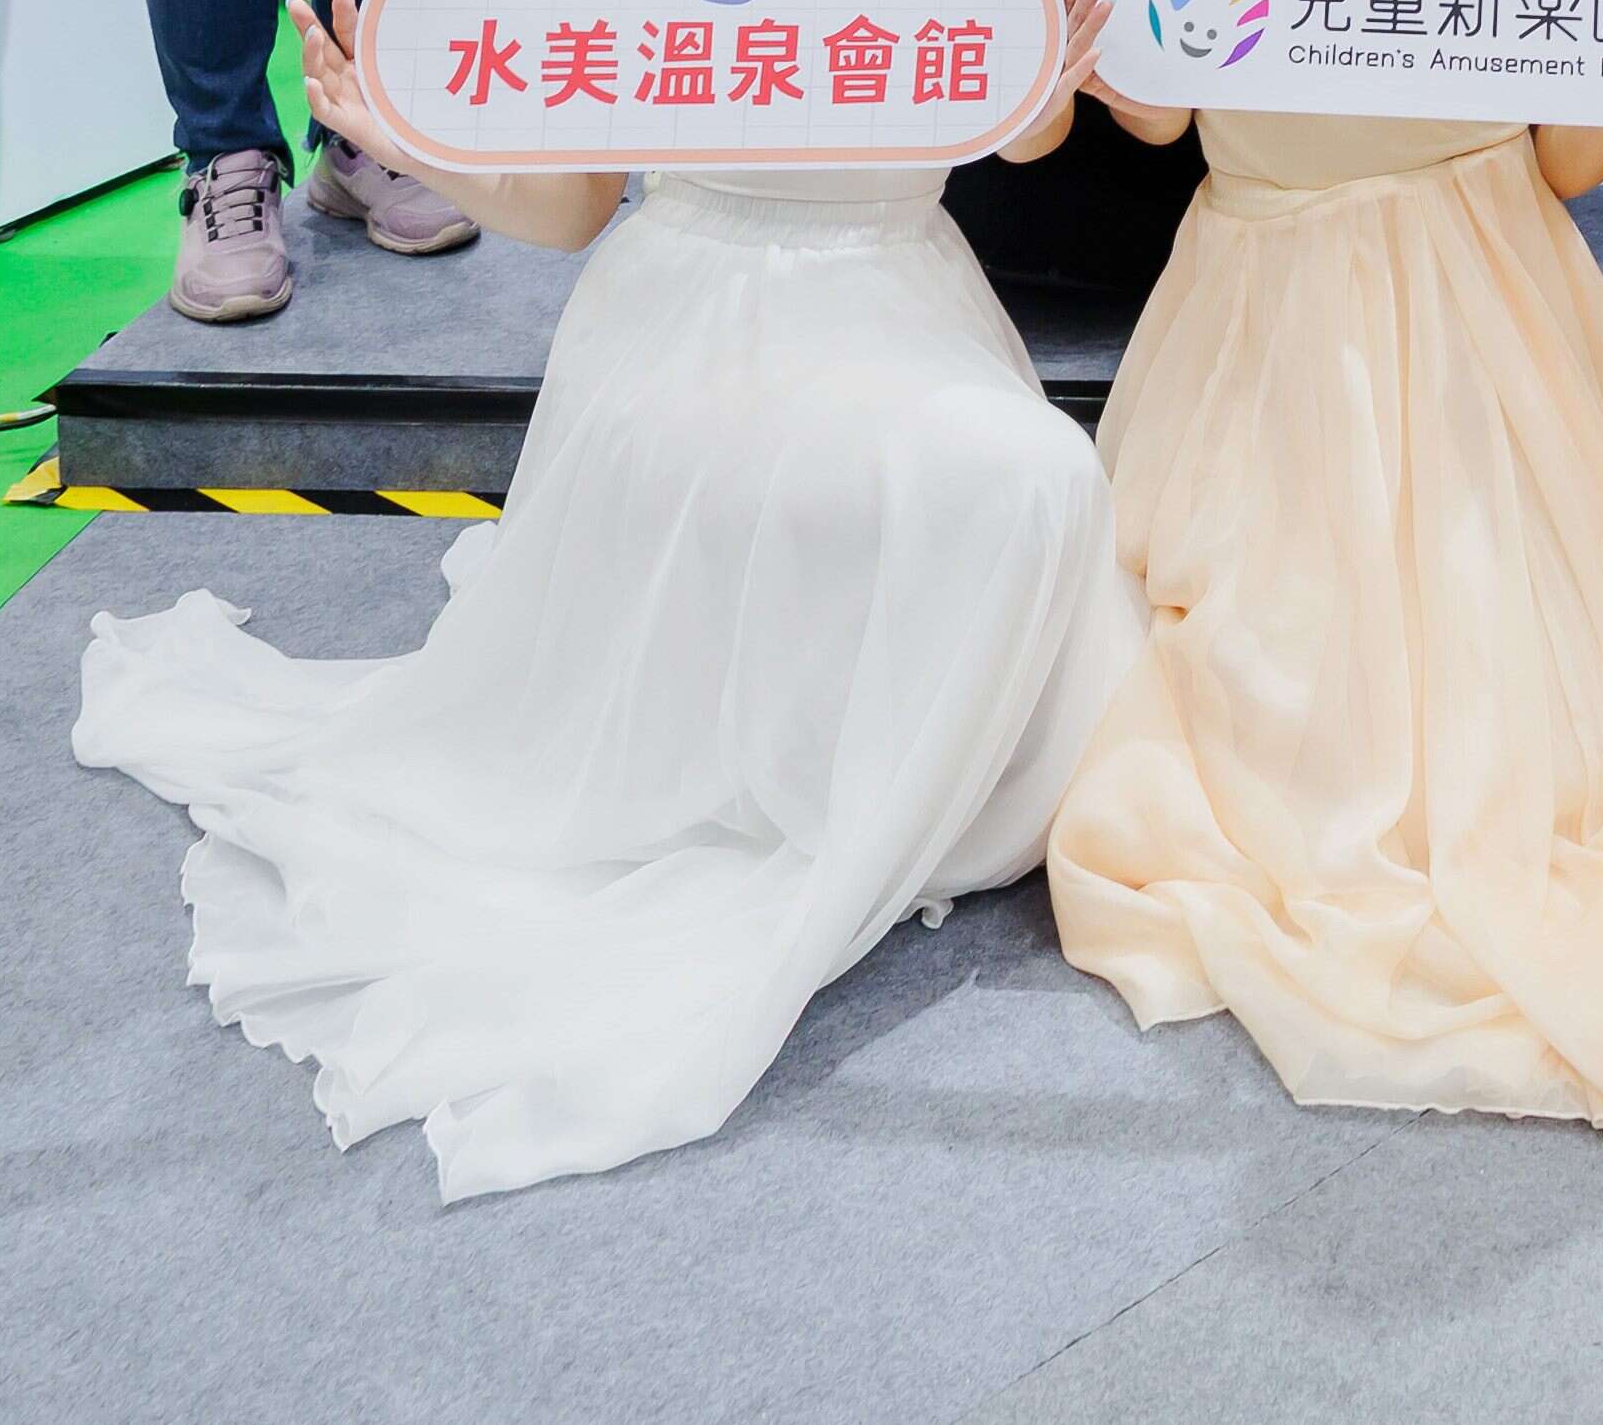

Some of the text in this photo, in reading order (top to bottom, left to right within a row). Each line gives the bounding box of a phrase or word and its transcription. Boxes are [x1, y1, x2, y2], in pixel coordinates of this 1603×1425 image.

[446, 16, 998, 110] 水美溫泉會館
[1287, 42, 1415, 72] Children's
[1429, 50, 1586, 80] Amusement
